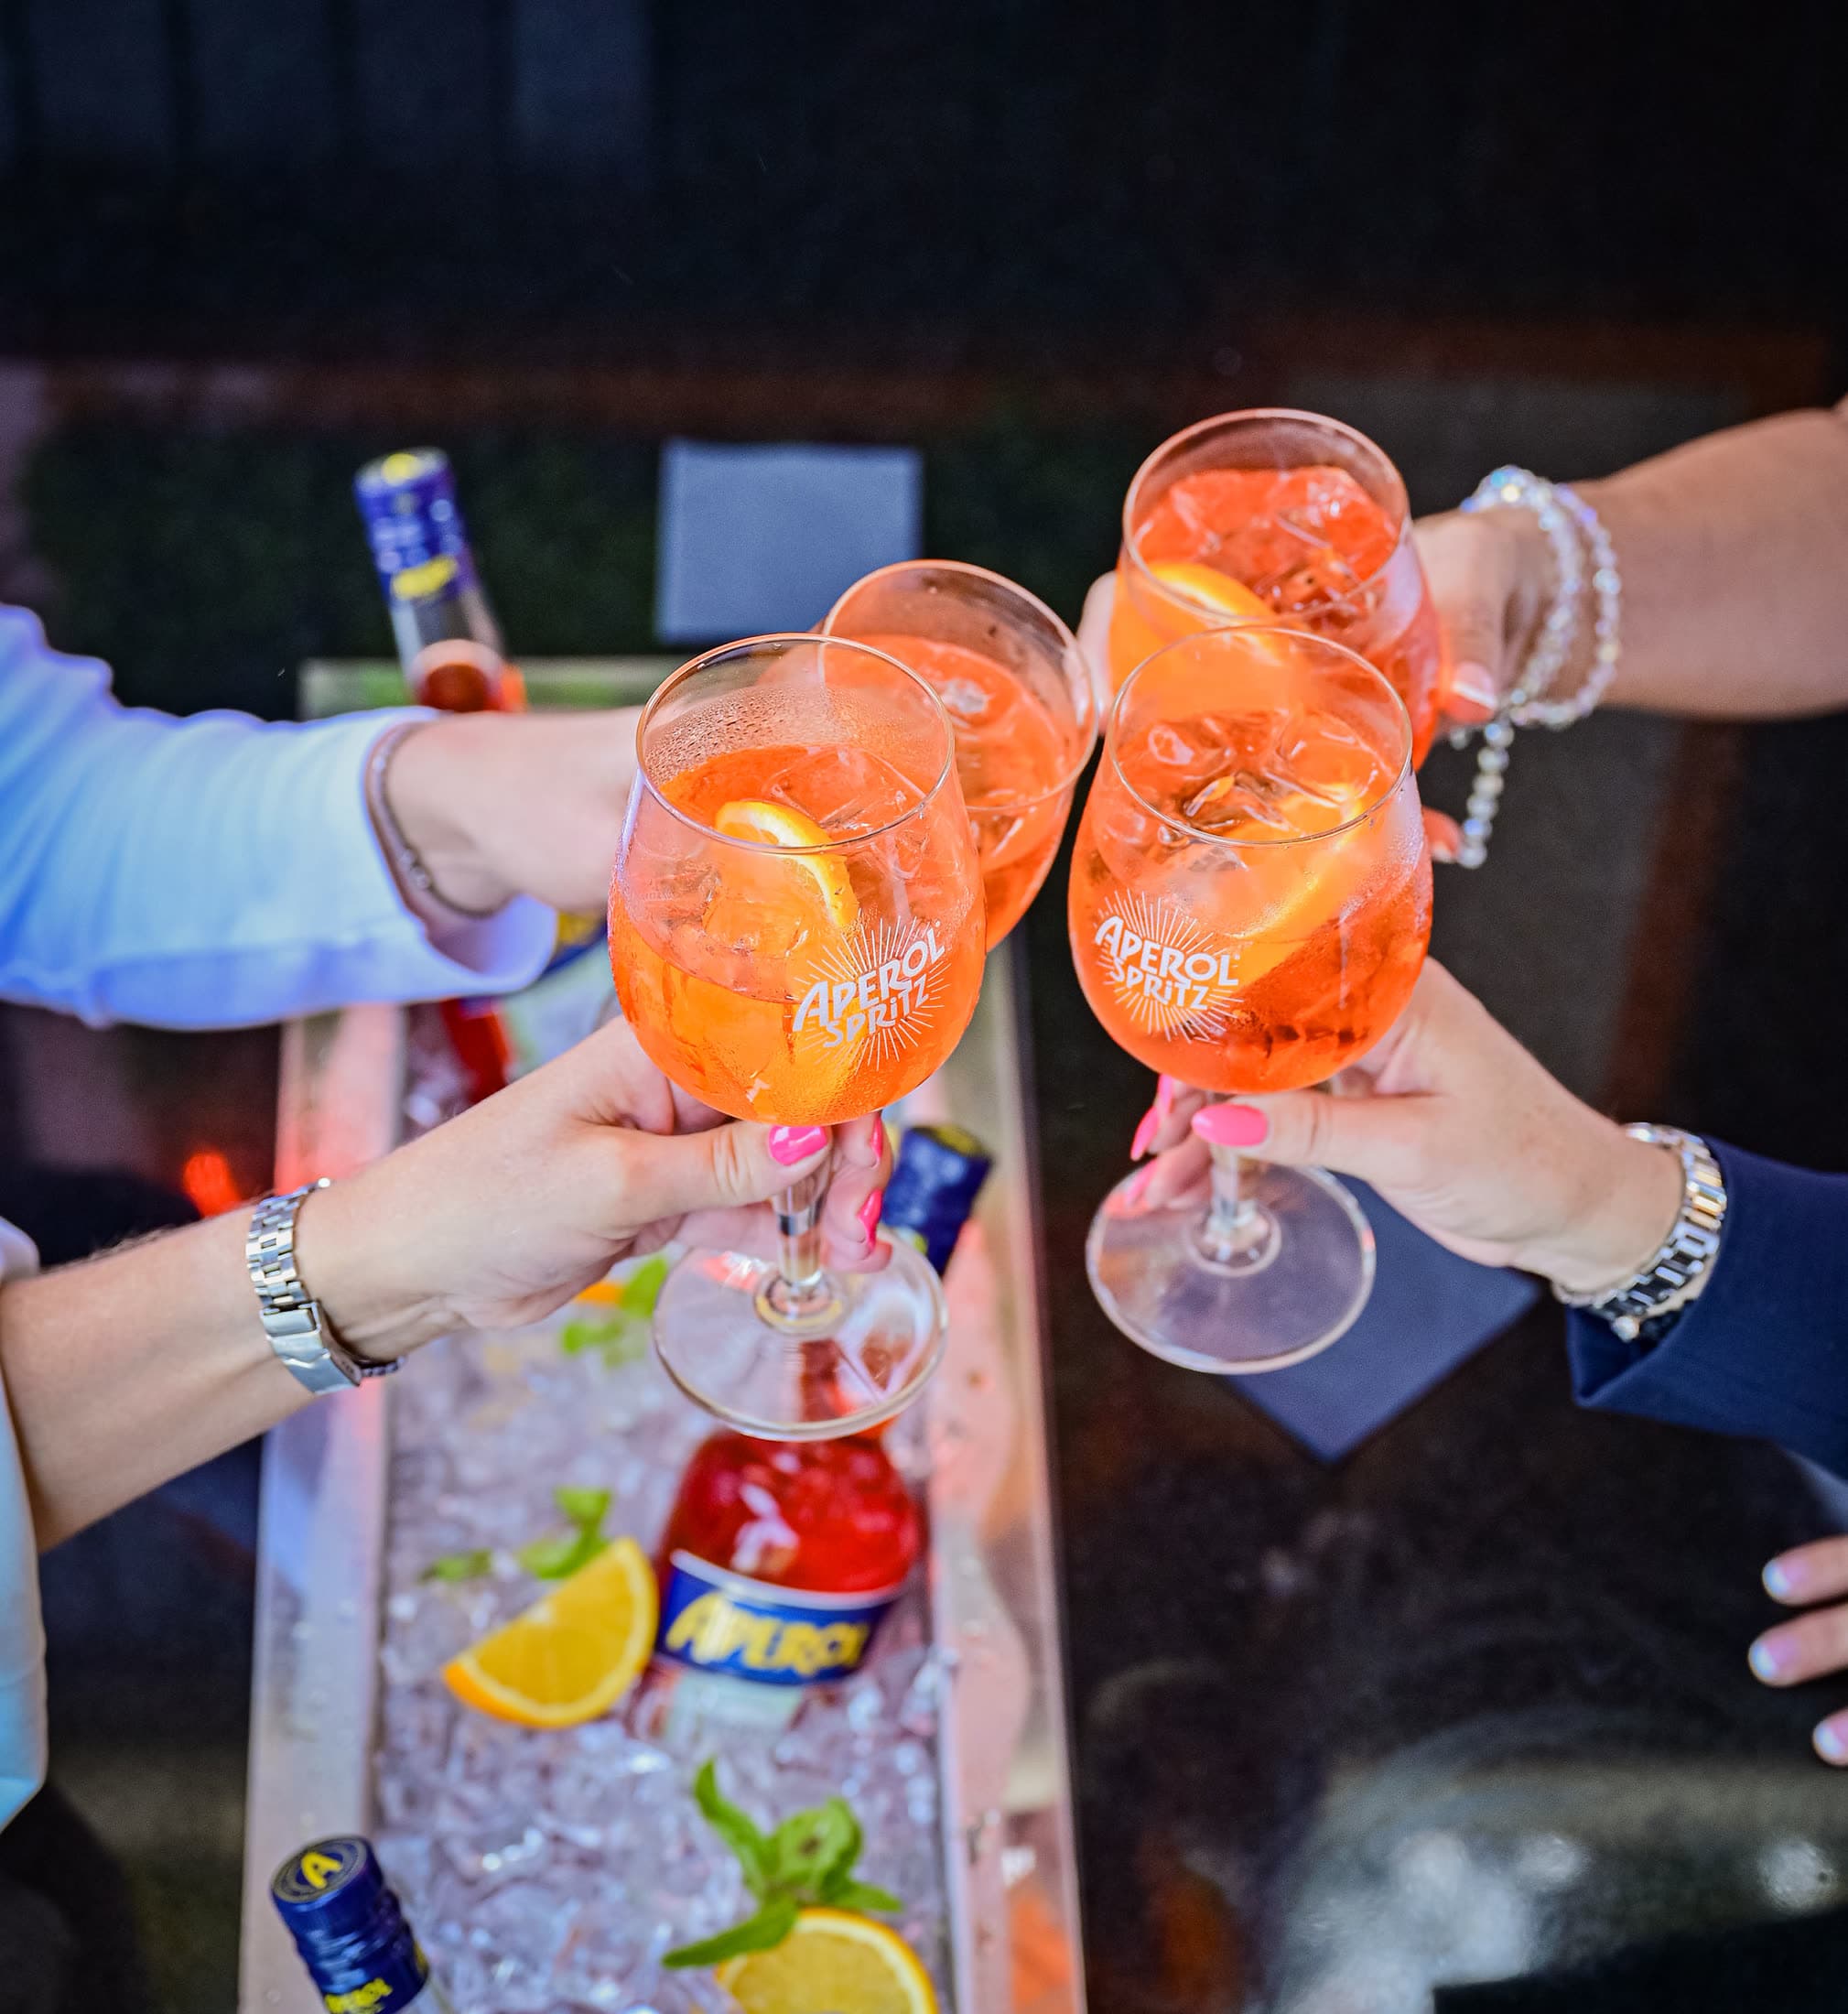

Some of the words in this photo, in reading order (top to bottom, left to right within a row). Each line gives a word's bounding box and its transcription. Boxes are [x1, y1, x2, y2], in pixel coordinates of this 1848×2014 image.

[792, 927, 946, 1033] APEROL
[1094, 915, 1238, 986] APEROL
[300, 1851, 342, 1889] A
